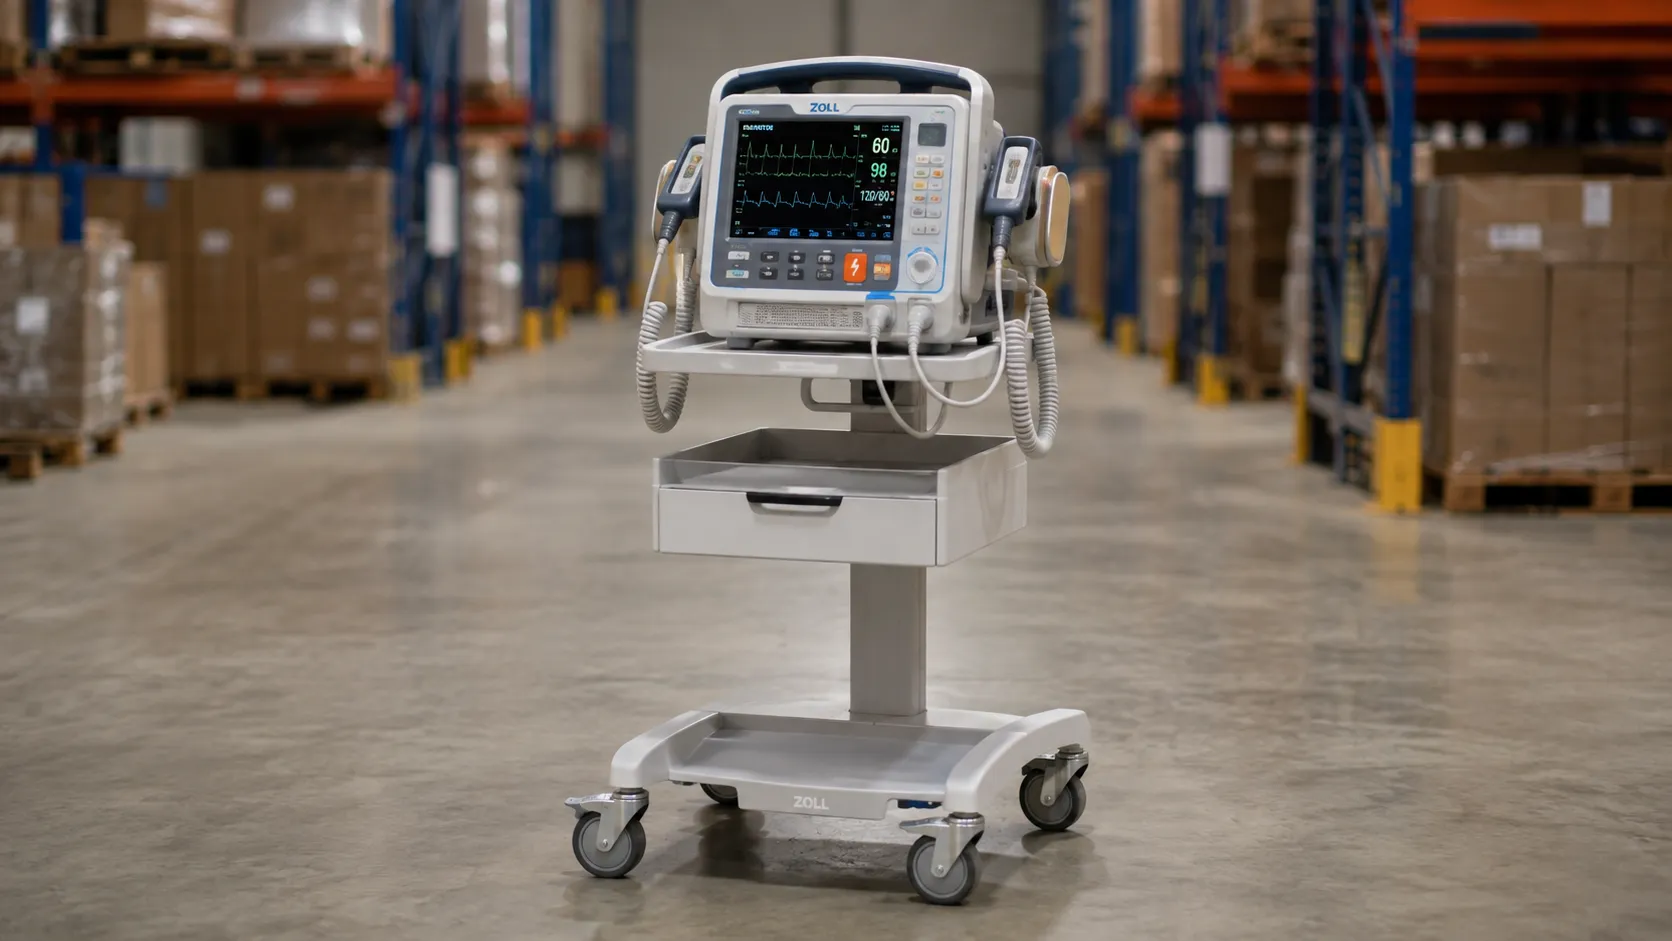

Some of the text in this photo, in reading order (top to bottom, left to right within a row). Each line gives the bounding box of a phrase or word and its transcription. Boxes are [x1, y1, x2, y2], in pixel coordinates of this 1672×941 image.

[809, 102, 840, 113] ZOLL
[872, 137, 890, 154] 60
[870, 162, 888, 178] 98
[793, 795, 830, 810] ZOLL
